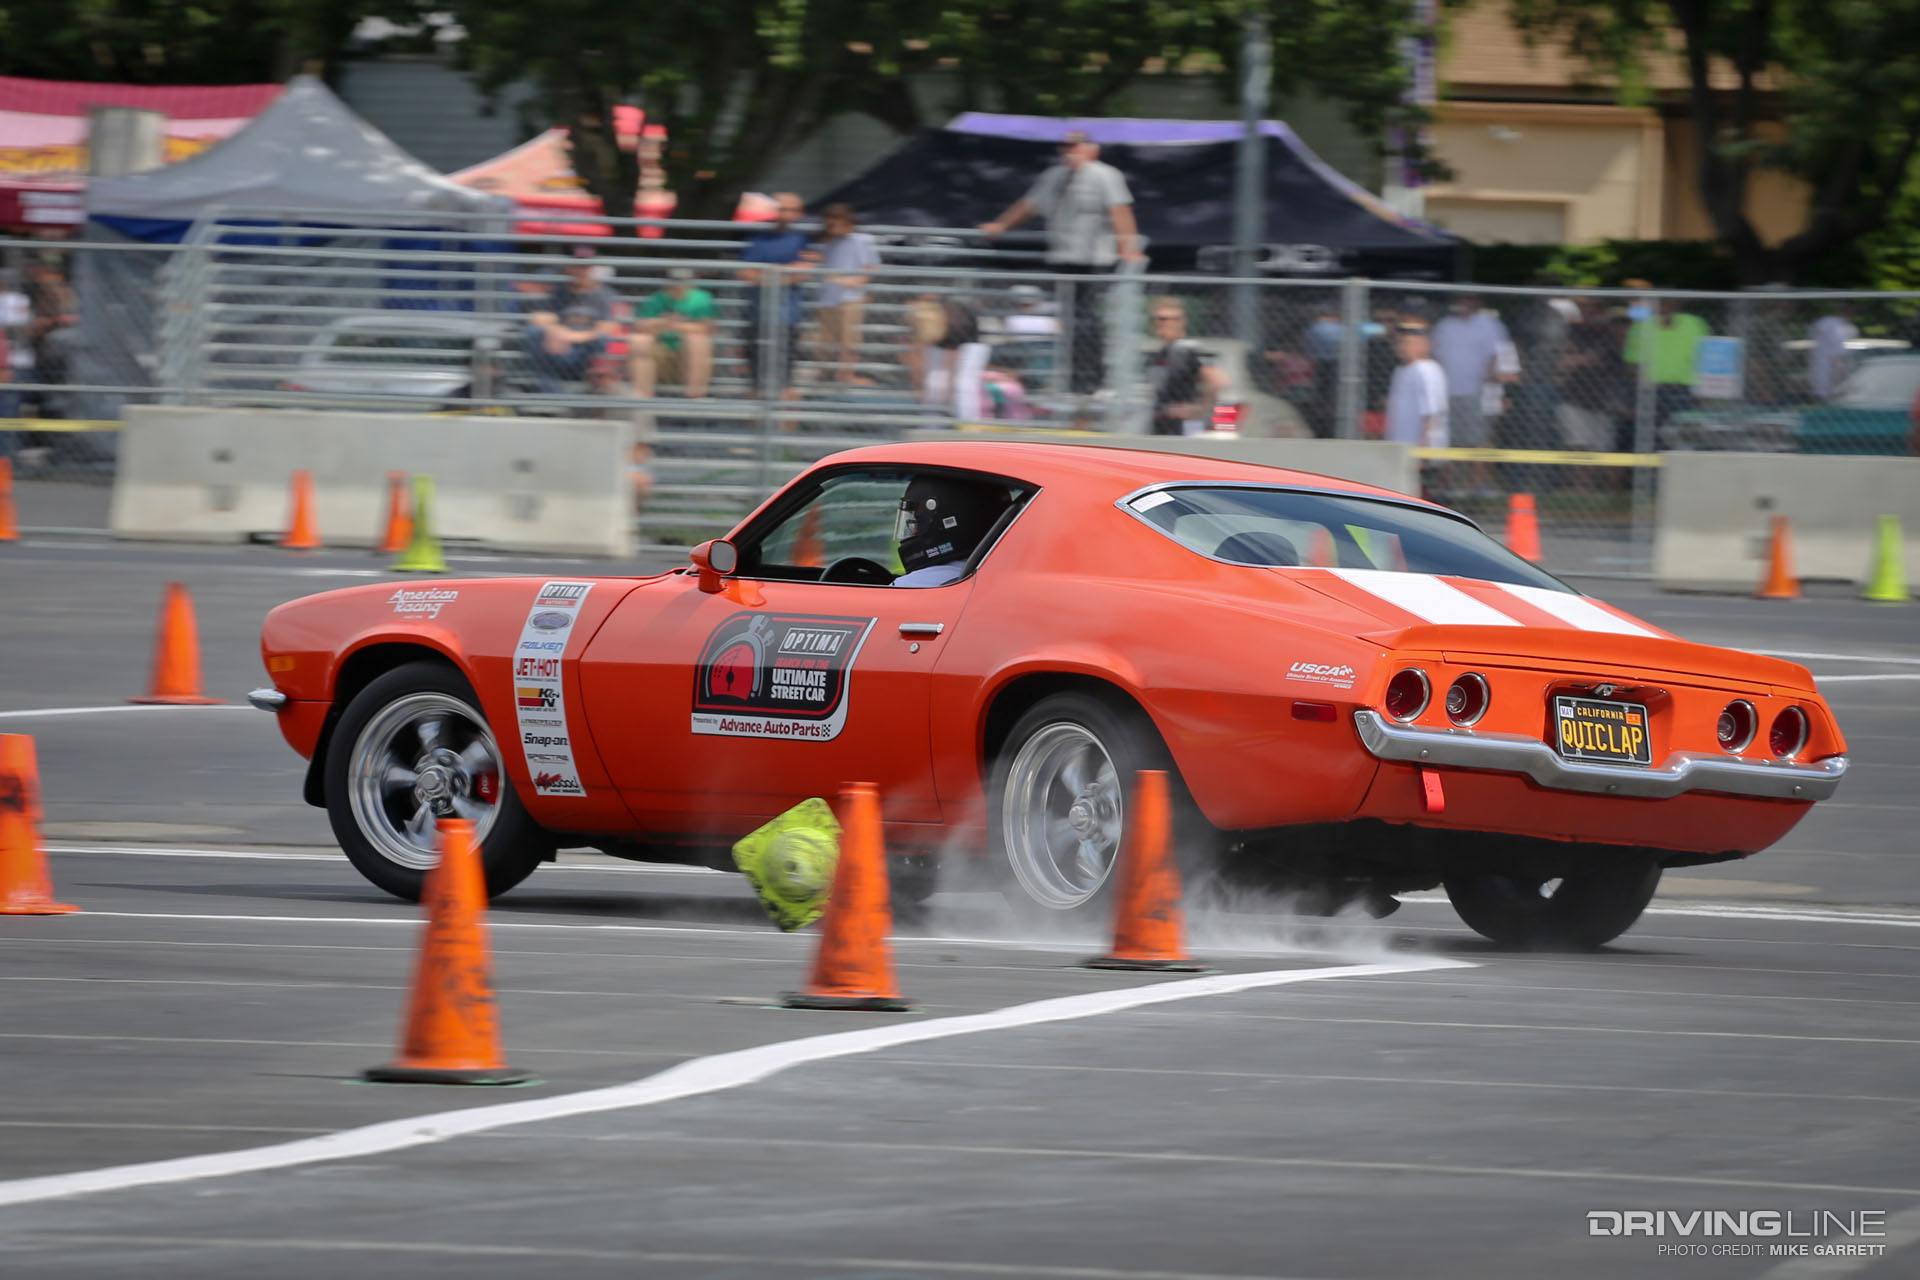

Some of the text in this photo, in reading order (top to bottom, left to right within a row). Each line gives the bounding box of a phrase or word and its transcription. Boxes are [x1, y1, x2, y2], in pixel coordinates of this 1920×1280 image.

[389, 587, 459, 602] American
[393, 602, 443, 619] Racing
[520, 641, 564, 653] FALKEN
[783, 632, 841, 652] OPTIMA
[516, 658, 559, 677] JET-HOT
[1290, 661, 1341, 676] USCA
[772, 668, 827, 687] ULTIMATE
[770, 685, 825, 702] STREET CAR
[1561, 708, 1573, 717] MAY
[1576, 707, 1625, 721] CALIFORNIA
[719, 718, 820, 737] Advance Auto Parts
[524, 732, 568, 747] Snap-on
[1561, 719, 1643, 755] QUICLAP
